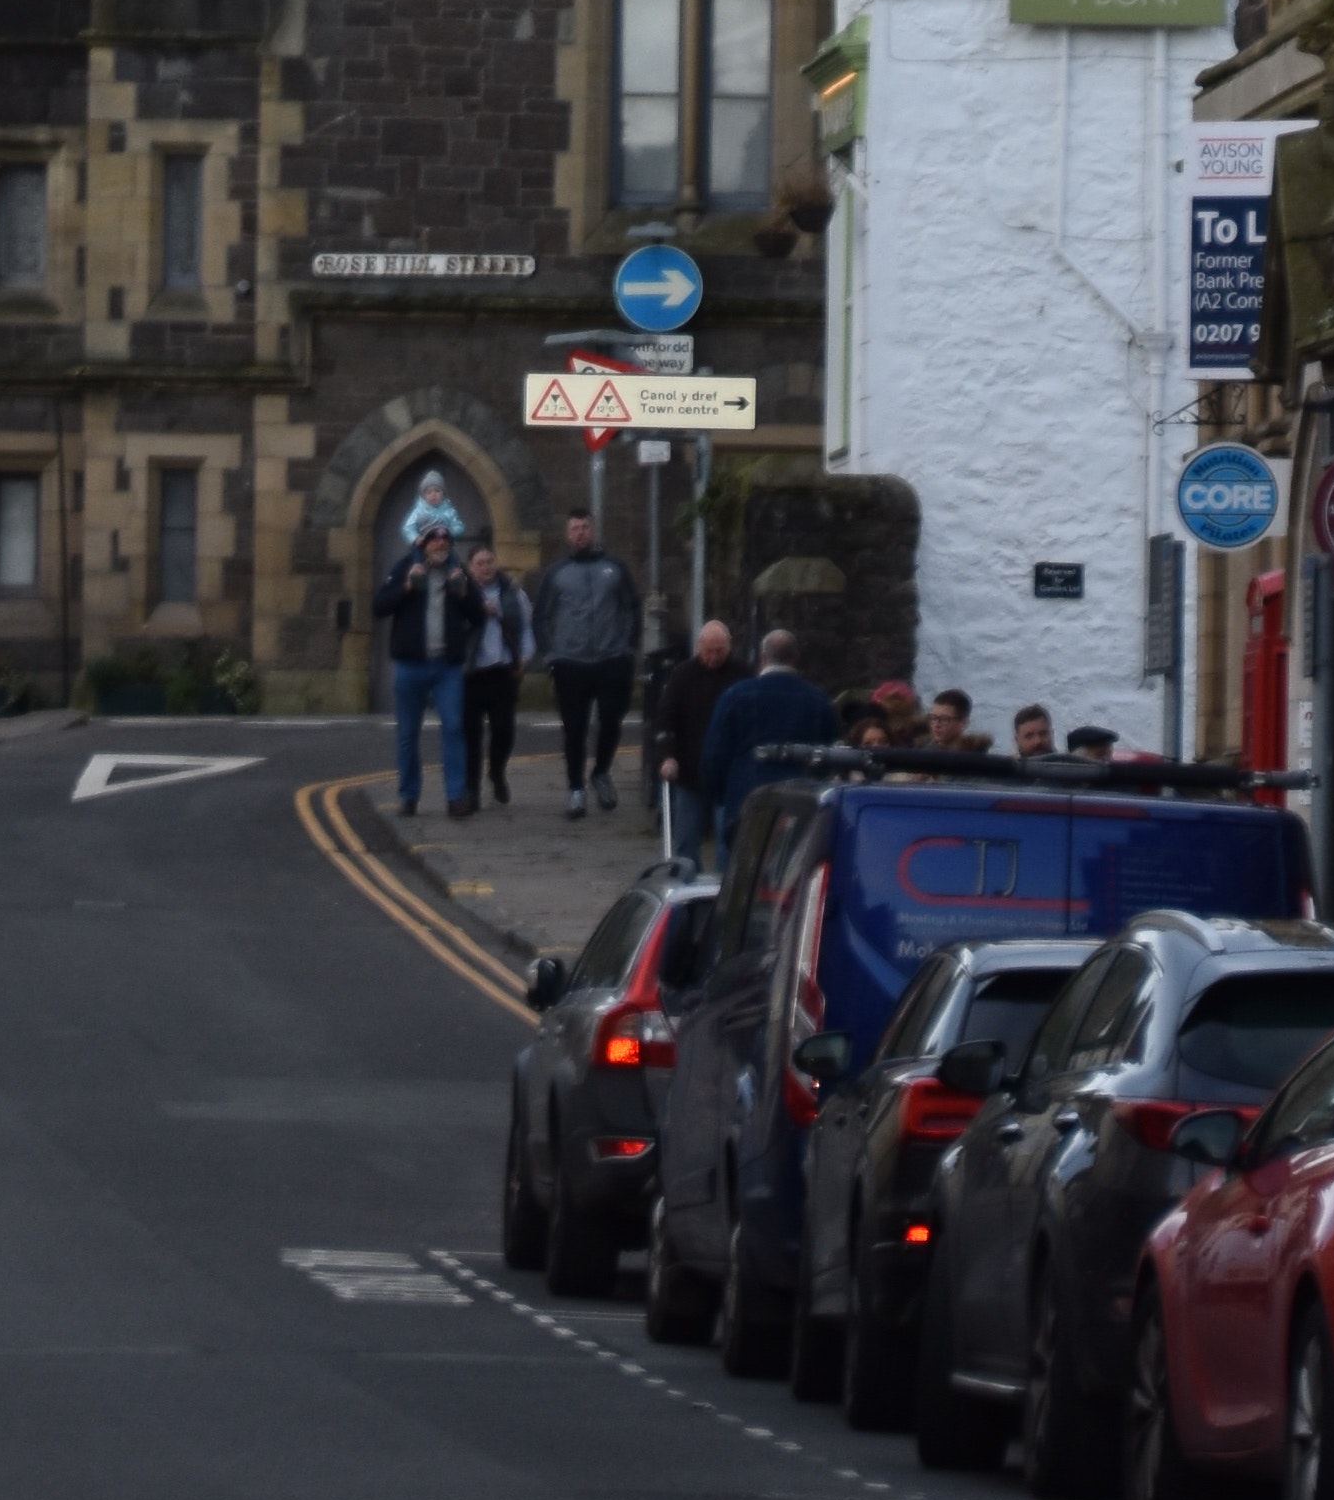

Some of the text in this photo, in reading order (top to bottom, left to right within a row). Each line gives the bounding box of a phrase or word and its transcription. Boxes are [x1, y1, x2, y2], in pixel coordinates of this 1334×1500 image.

[1200, 142, 1265, 159] AVISON
[1200, 159, 1264, 175] YOUNG
[1196, 209, 1238, 245] To
[322, 255, 378, 273] ROSE
[1195, 251, 1254, 269] Former
[1195, 271, 1265, 290] Bank Pre
[1194, 292, 1222, 312] (A2
[1194, 323, 1244, 342] 0207
[640, 389, 719, 402] Canol y dref
[640, 403, 720, 415] Town centre
[1185, 483, 1272, 510] CORE
